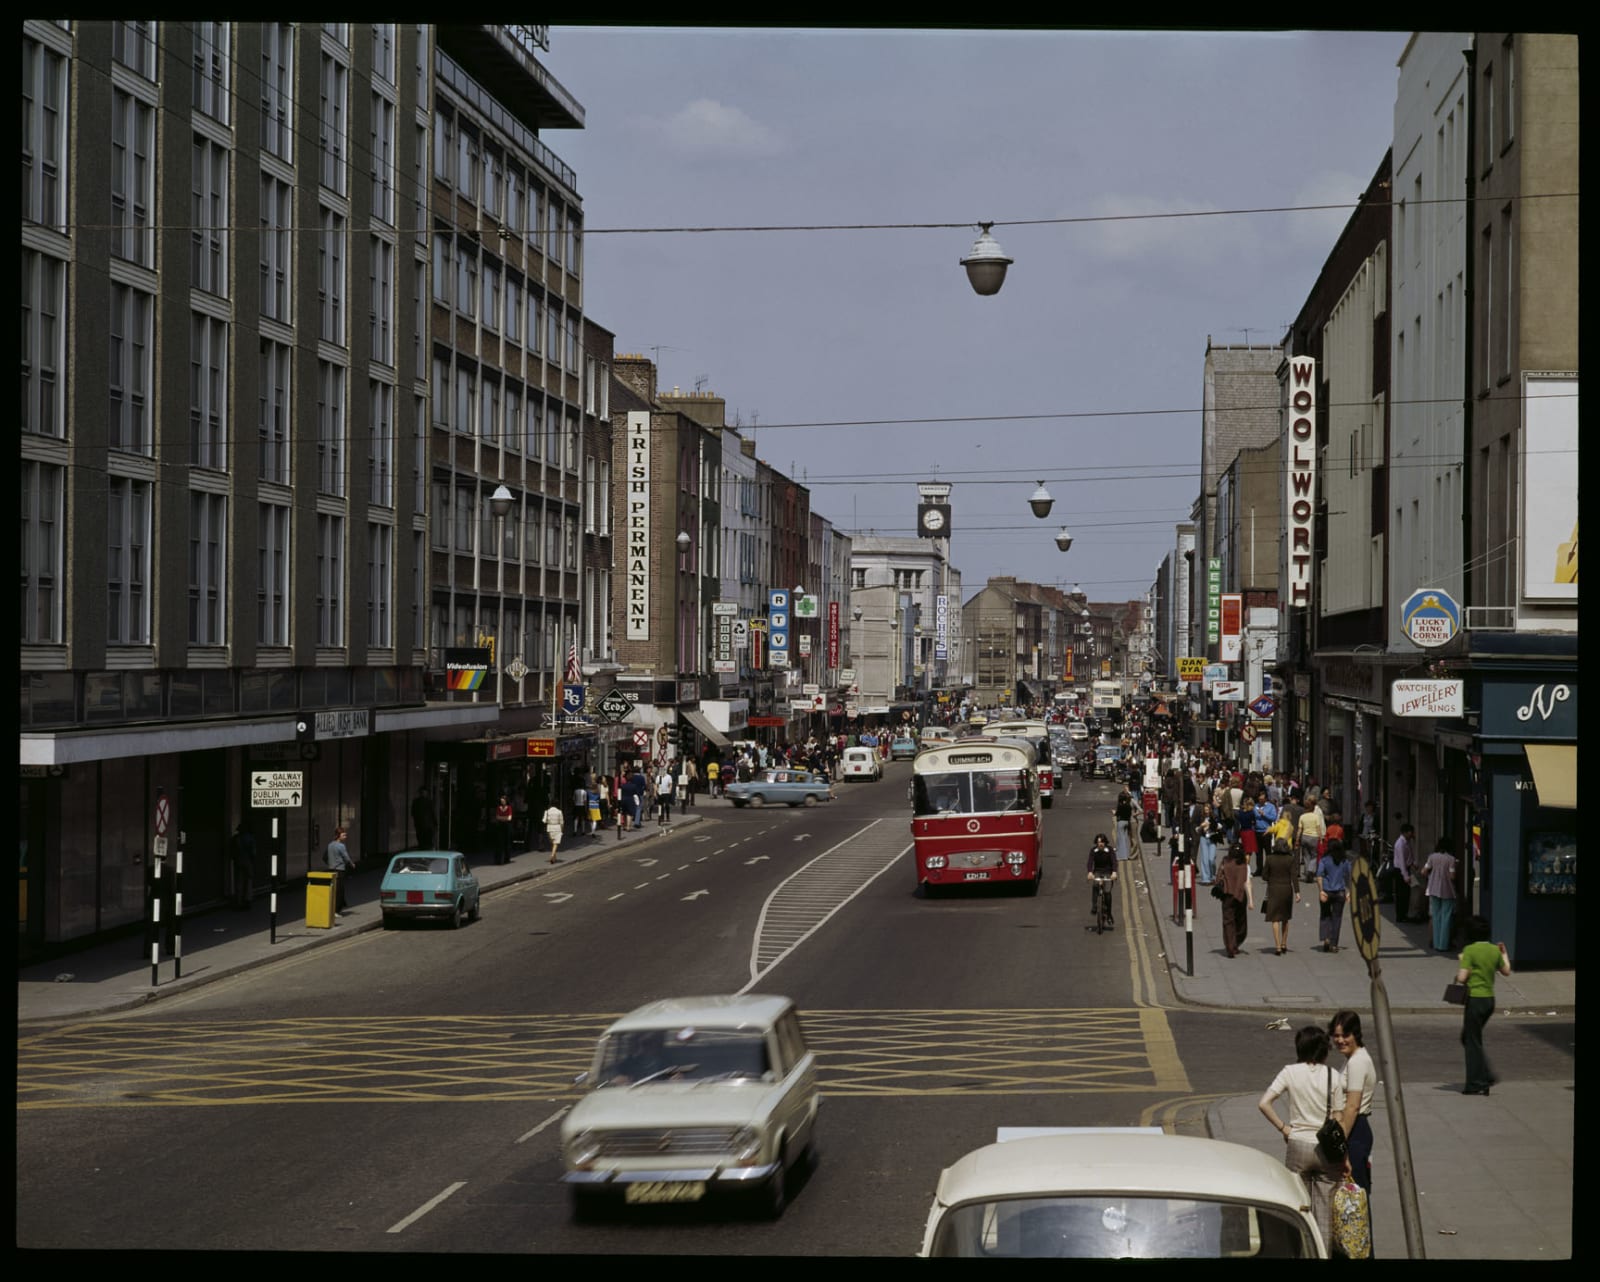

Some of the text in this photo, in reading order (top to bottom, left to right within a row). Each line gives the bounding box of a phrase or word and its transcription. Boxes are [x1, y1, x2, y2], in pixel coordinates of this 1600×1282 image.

[1292, 362, 1312, 603] WOOLWORTH
[631, 422, 646, 630] IRISH PERMANENT
[774, 596, 784, 644] RTV
[938, 597, 946, 649] ROCHES
[1209, 559, 1220, 644] NESTORS
[1396, 684, 1438, 692] WATCHES
[1399, 683, 1459, 715] JEWELLERY
[1428, 704, 1456, 713] RINGS
[337, 712, 351, 731] IRISH
[353, 711, 369, 730] BANK
